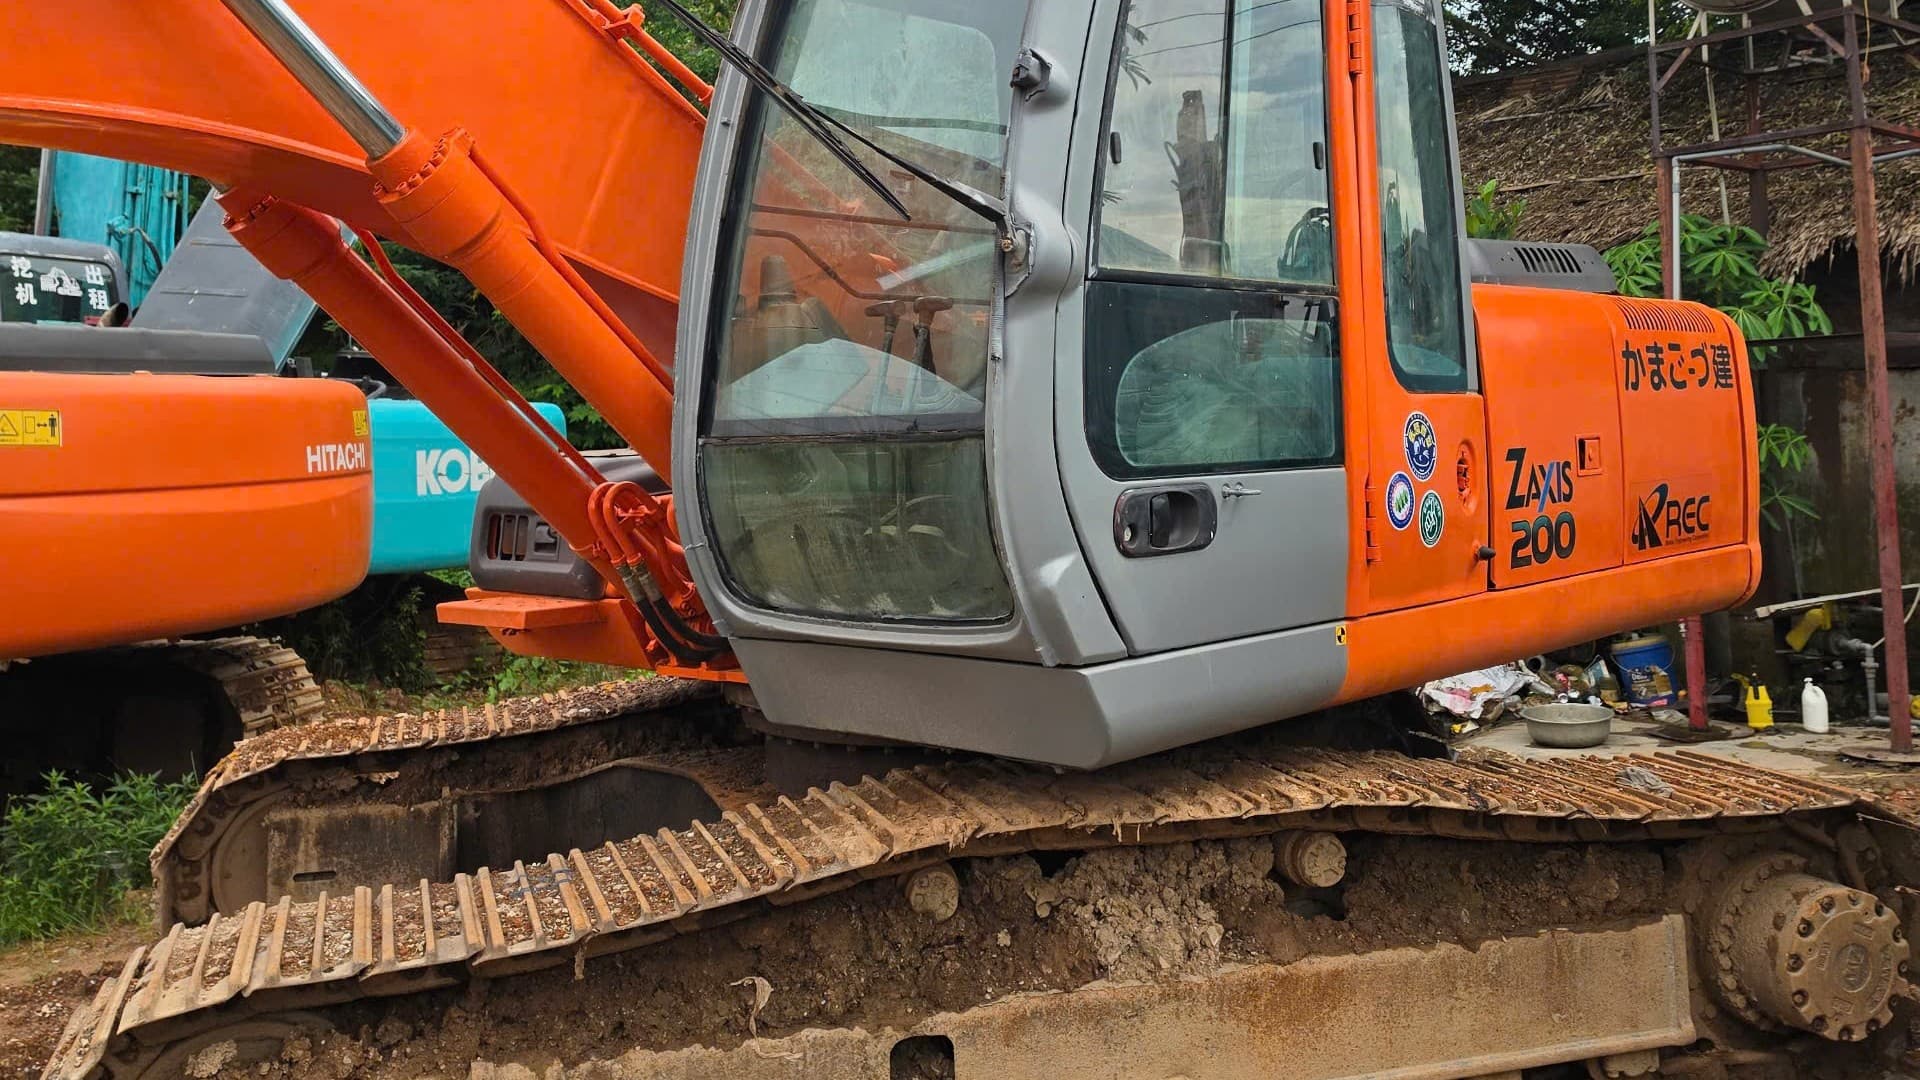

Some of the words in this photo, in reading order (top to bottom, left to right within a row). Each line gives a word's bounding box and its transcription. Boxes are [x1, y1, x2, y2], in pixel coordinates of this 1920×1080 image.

[10, 255, 38, 306] 挖机
[84, 264, 111, 310] 出租
[306, 442, 366, 473] HITACHI
[1505, 447, 1574, 513] ZAXIS
[1510, 511, 1576, 570] 200
[1665, 495, 1711, 539] REC
